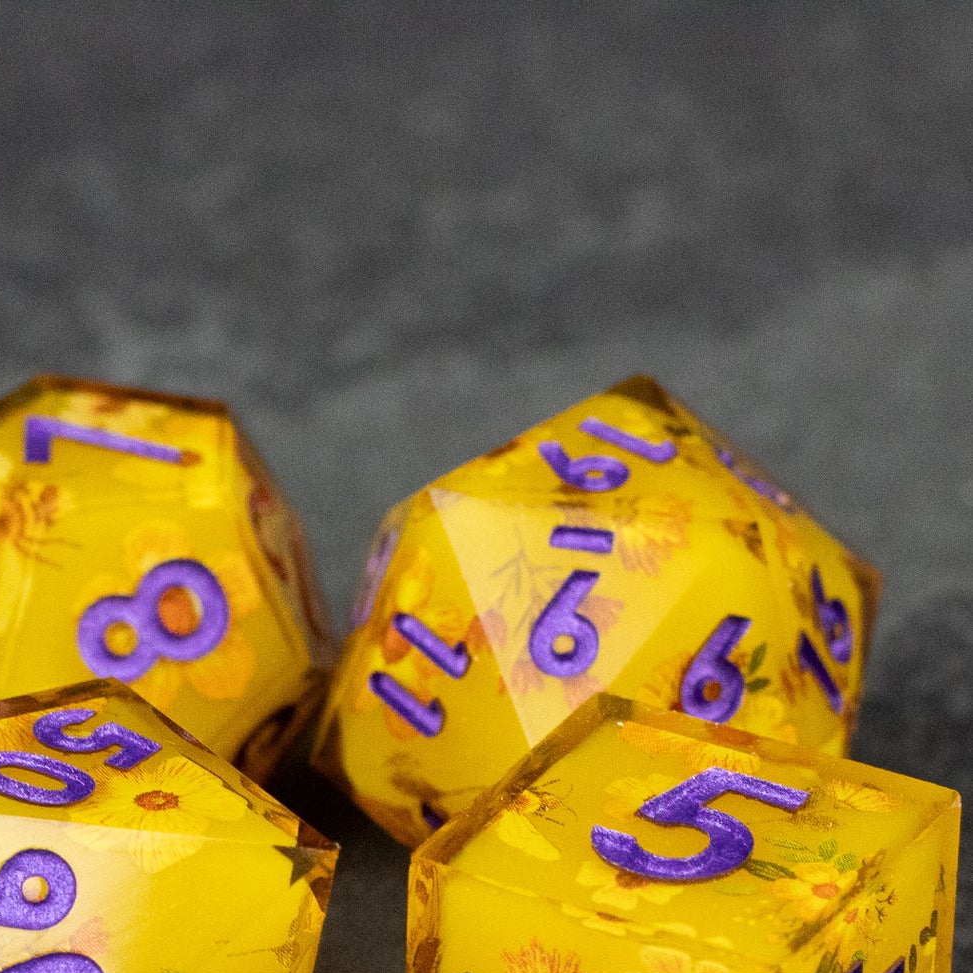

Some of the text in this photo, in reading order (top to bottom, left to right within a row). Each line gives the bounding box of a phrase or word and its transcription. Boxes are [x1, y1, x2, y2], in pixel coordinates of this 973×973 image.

[77, 558, 230, 684] 8
[367, 612, 472, 738] 11
[591, 766, 811, 883] 5
